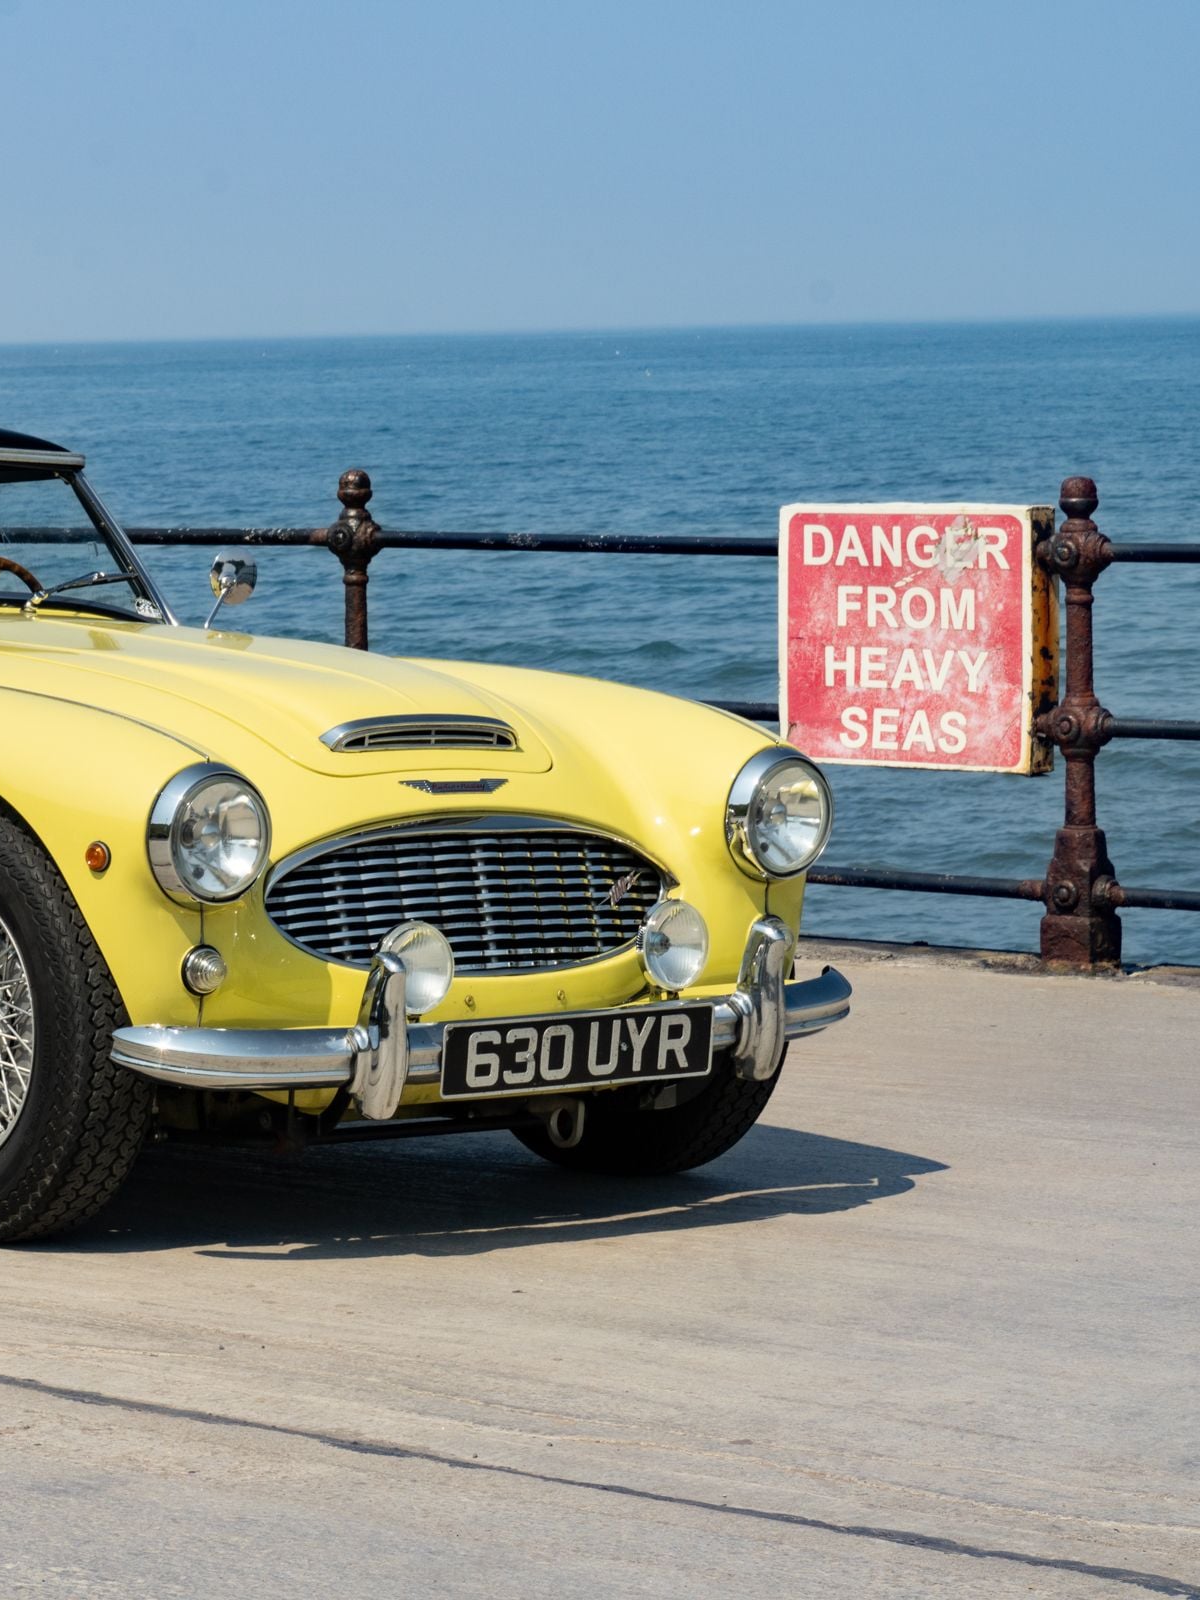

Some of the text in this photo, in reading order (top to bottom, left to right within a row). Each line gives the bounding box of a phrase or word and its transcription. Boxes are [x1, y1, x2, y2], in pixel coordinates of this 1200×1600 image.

[837, 584, 976, 631] FROM
[824, 645, 989, 693] HEAVY
[838, 706, 968, 755] SEAS
[465, 1013, 692, 1088] 630 UYR
